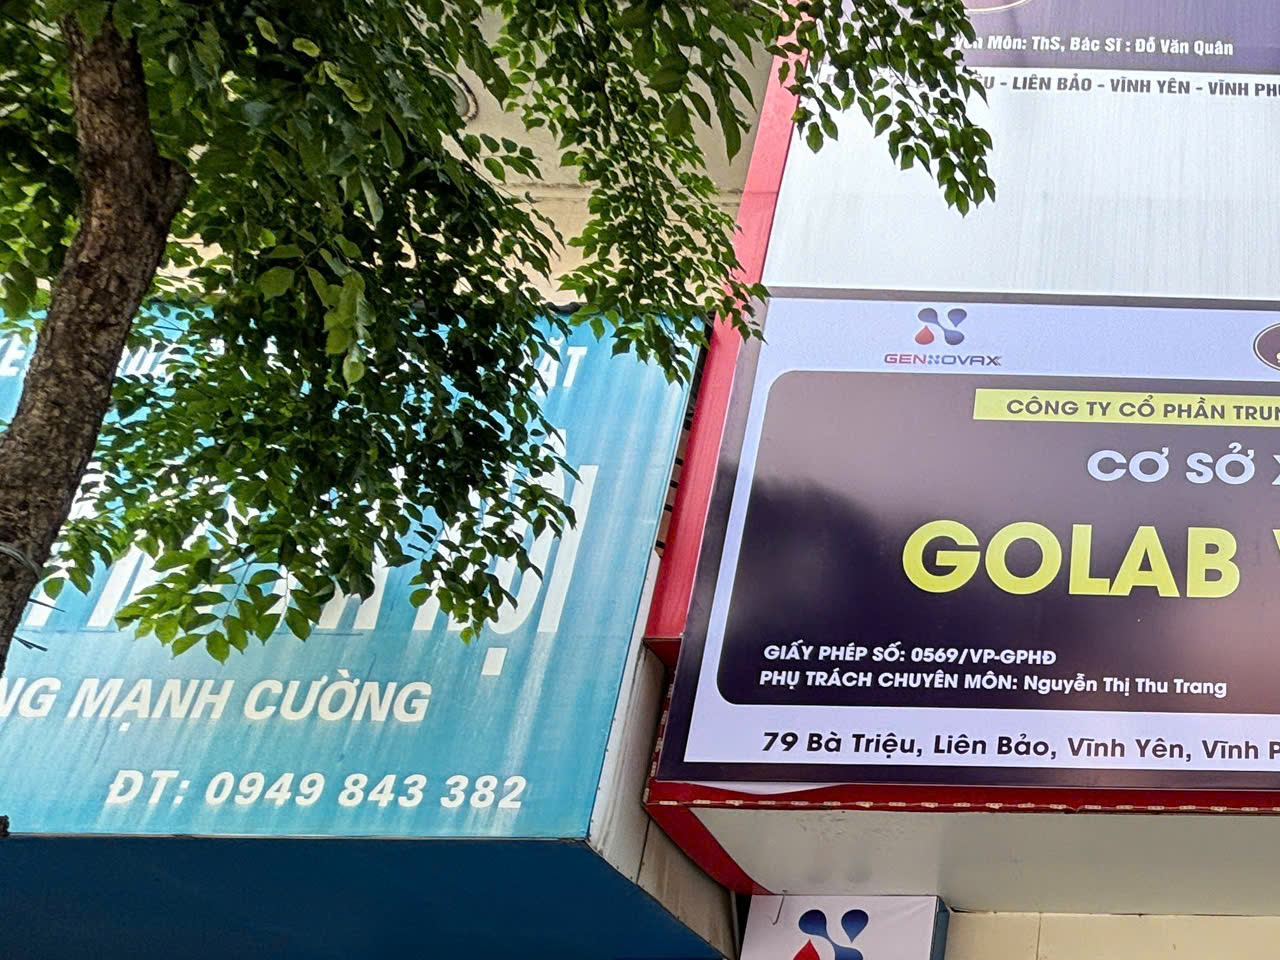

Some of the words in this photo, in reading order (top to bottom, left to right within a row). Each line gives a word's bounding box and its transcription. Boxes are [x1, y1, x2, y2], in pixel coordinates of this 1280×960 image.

[987, 36, 1027, 50] Môn:
[1070, 37, 1100, 51] Bác
[1160, 39, 1189, 55] Văn
[1193, 40, 1234, 56] Quân
[1012, 74, 1050, 90] LIÊN
[1057, 73, 1092, 91] BẢO
[1110, 77, 1151, 93] VĨNH
[1157, 78, 1191, 95] YÊN
[1208, 80, 1249, 96] VĨNH
[1006, 396, 1079, 416] CÔNG
[1086, 401, 1111, 416] TY
[1118, 395, 1155, 418] CỔ
[1163, 397, 1225, 419] PHẦN
[1087, 447, 1170, 483] CƠ
[1186, 442, 1256, 485] SỞ
[902, 519, 1241, 599] GOLAB
[764, 639, 813, 660] GIẤY
[818, 643, 868, 661] PHÉP
[872, 641, 905, 662] SỐ:
[911, 648, 1056, 665] 0569/VP-GPHĐ
[760, 671, 799, 690] PHỤ
[806, 668, 872, 687] TRÁCH
[878, 669, 958, 688] CHUYÊN
[964, 671, 1017, 690] MÔN:
[1024, 673, 1097, 694] Nguyễn
[1103, 677, 1130, 696] Thị
[1135, 678, 1168, 693] Thu
[1174, 678, 1227, 698] Trang
[67, 678, 234, 732] MẠNH
[244, 669, 432, 722] CƯỜNG
[763, 731, 798, 752] 79
[807, 731, 842, 752] Bà
[851, 732, 922, 758] Triệu,
[934, 734, 986, 754] Liên
[997, 733, 1057, 759] Bảo,
[1068, 737, 1125, 757] Vĩnh
[1135, 738, 1192, 762] Yên,
[1201, 739, 1259, 759] Vĩnh
[105, 770, 190, 806] ĐT:
[205, 771, 324, 807] 0949
[338, 773, 427, 808] 843
[440, 775, 526, 808] 382
